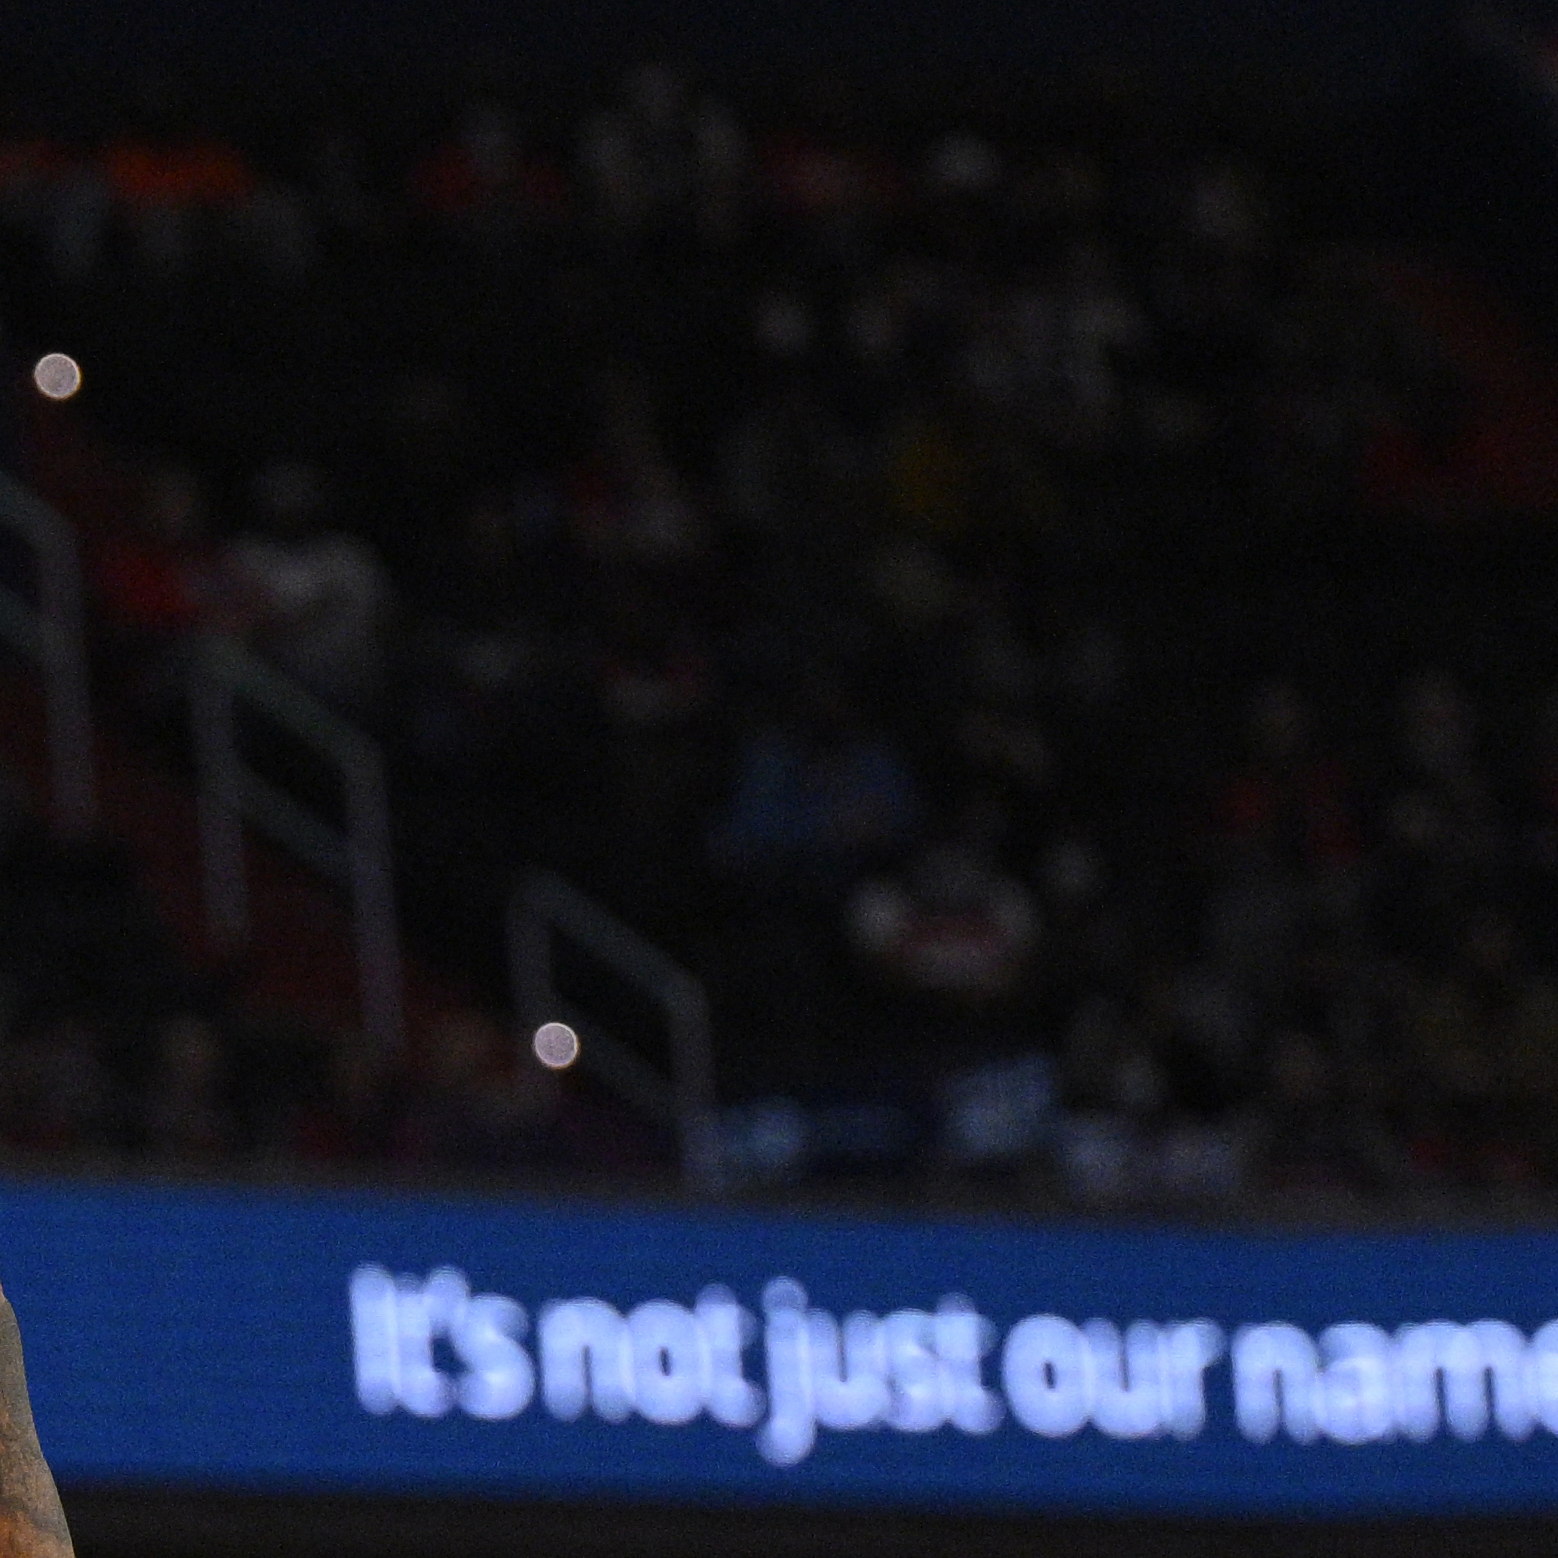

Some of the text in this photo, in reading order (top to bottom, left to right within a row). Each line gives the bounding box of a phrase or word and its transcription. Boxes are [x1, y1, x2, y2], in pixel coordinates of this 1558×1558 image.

[349, 1263, 534, 1420] It's
[539, 1283, 761, 1428] not
[756, 1275, 1001, 1468] just
[1002, 1312, 1222, 1440] our
